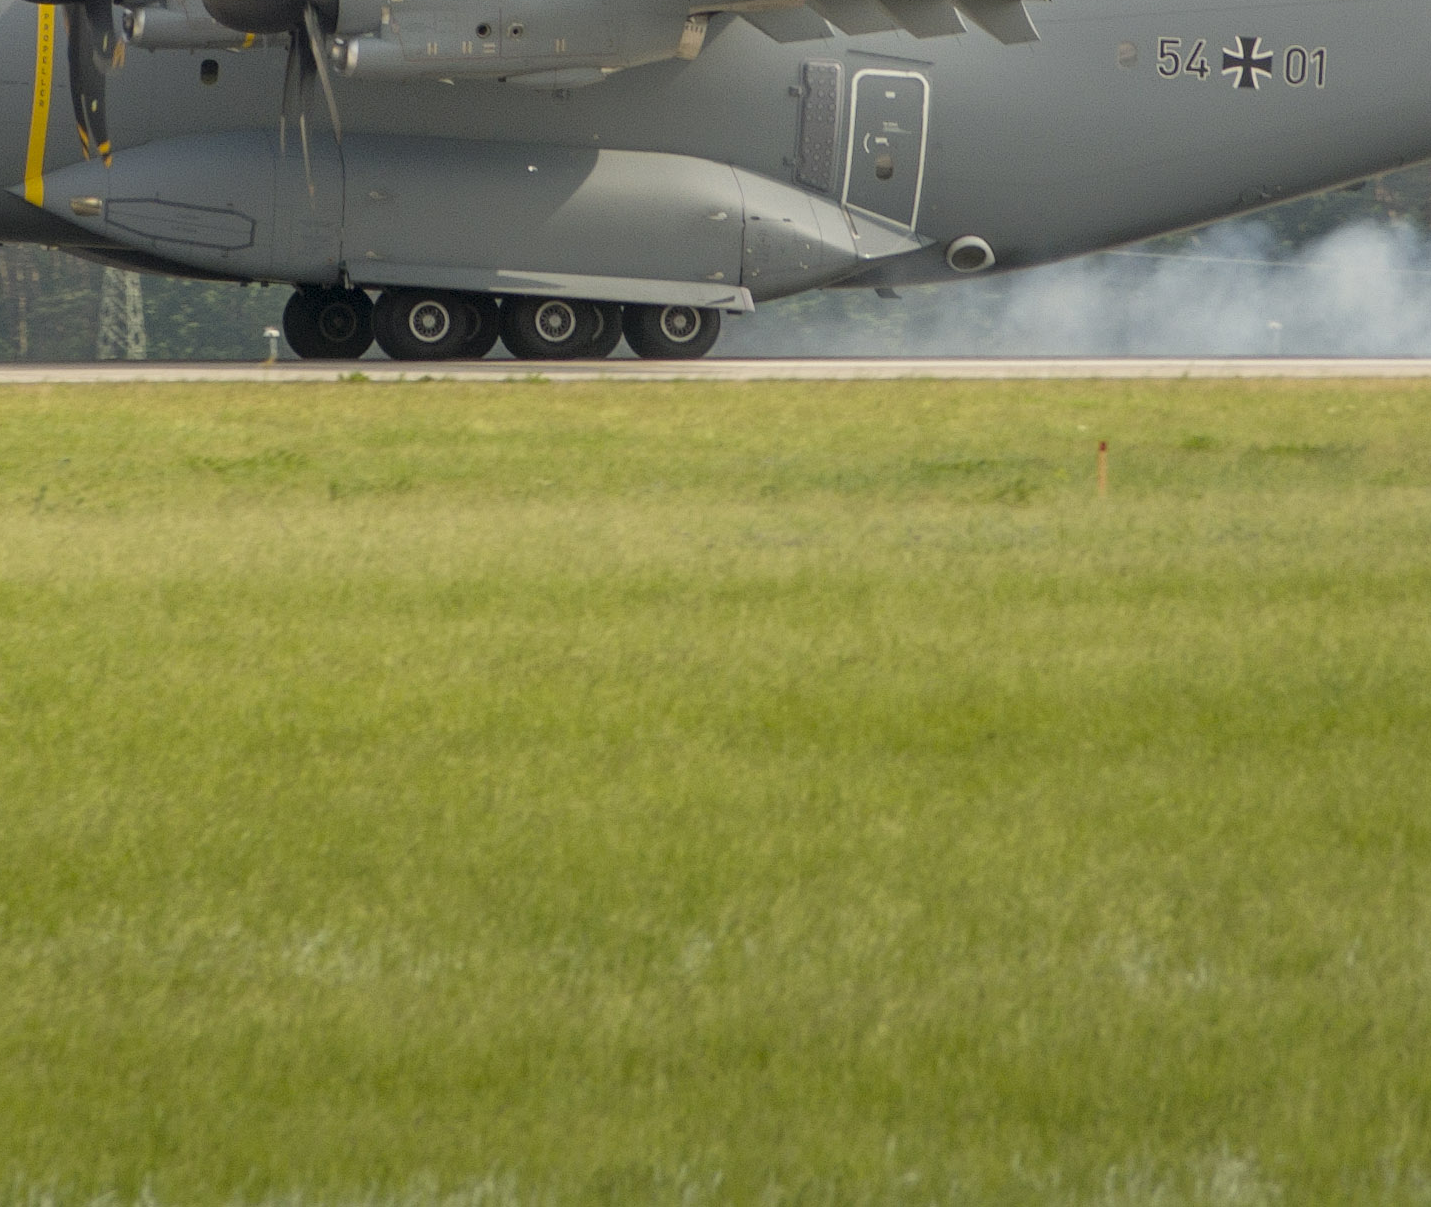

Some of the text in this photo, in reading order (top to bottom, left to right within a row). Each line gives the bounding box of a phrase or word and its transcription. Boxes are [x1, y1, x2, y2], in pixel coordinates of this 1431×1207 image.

[39, 13, 50, 108] PROPELLER
[1156, 36, 1327, 89] 54 01
